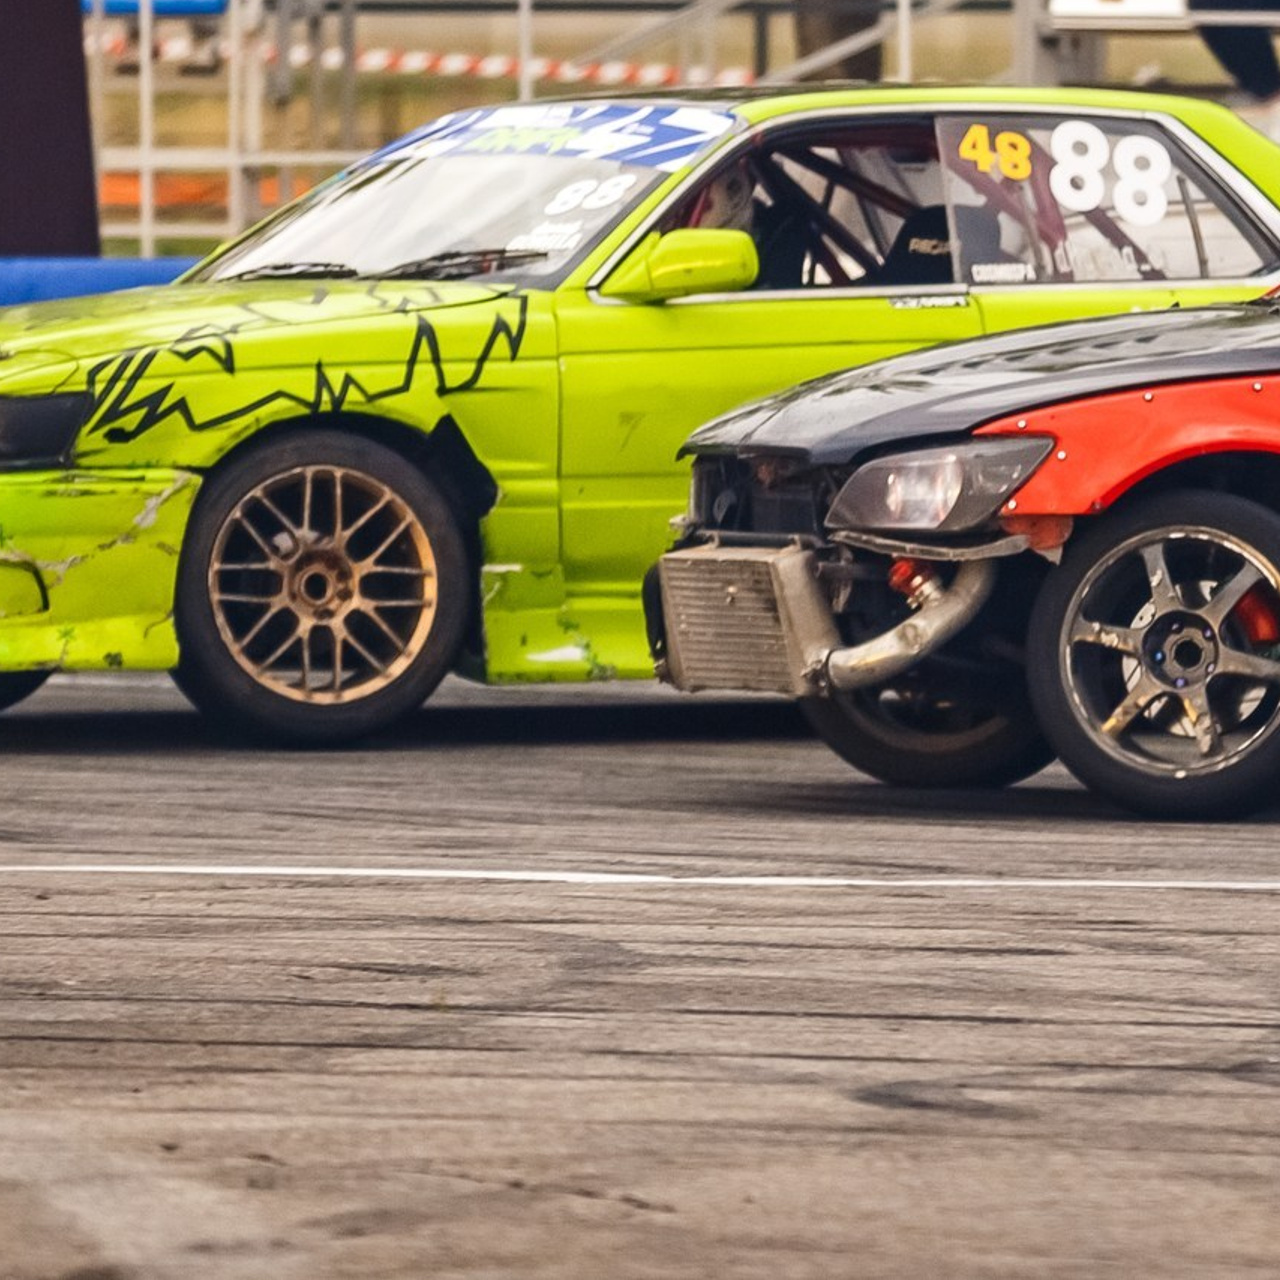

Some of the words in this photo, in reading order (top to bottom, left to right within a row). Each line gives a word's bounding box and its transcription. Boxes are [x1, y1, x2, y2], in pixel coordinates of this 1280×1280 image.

[958, 124, 1032, 181] 48
[1049, 120, 1172, 227] 88
[544, 174, 638, 216] 88
